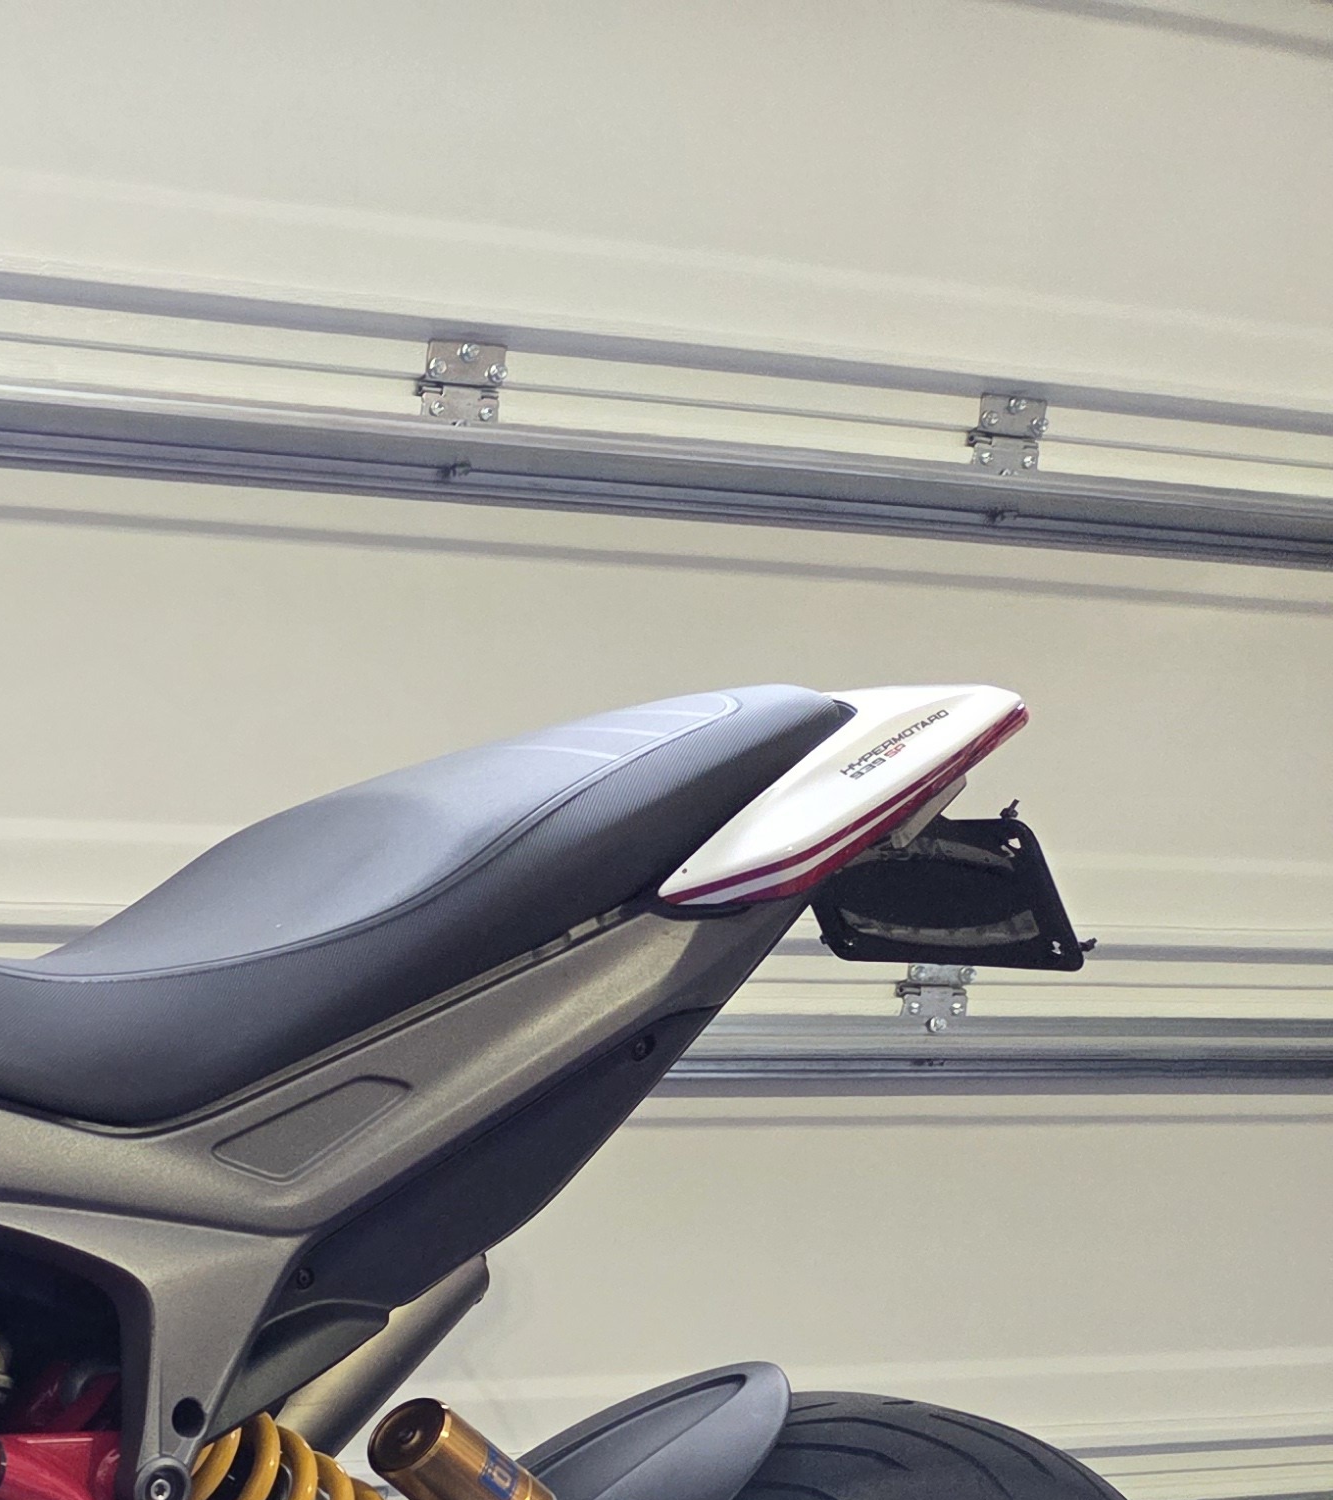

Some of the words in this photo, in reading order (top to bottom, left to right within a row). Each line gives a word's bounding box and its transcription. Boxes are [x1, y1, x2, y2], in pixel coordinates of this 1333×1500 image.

[840, 709, 949, 775] HYPERMOTARD
[850, 757, 886, 780] 939
[884, 743, 906, 758] SP
